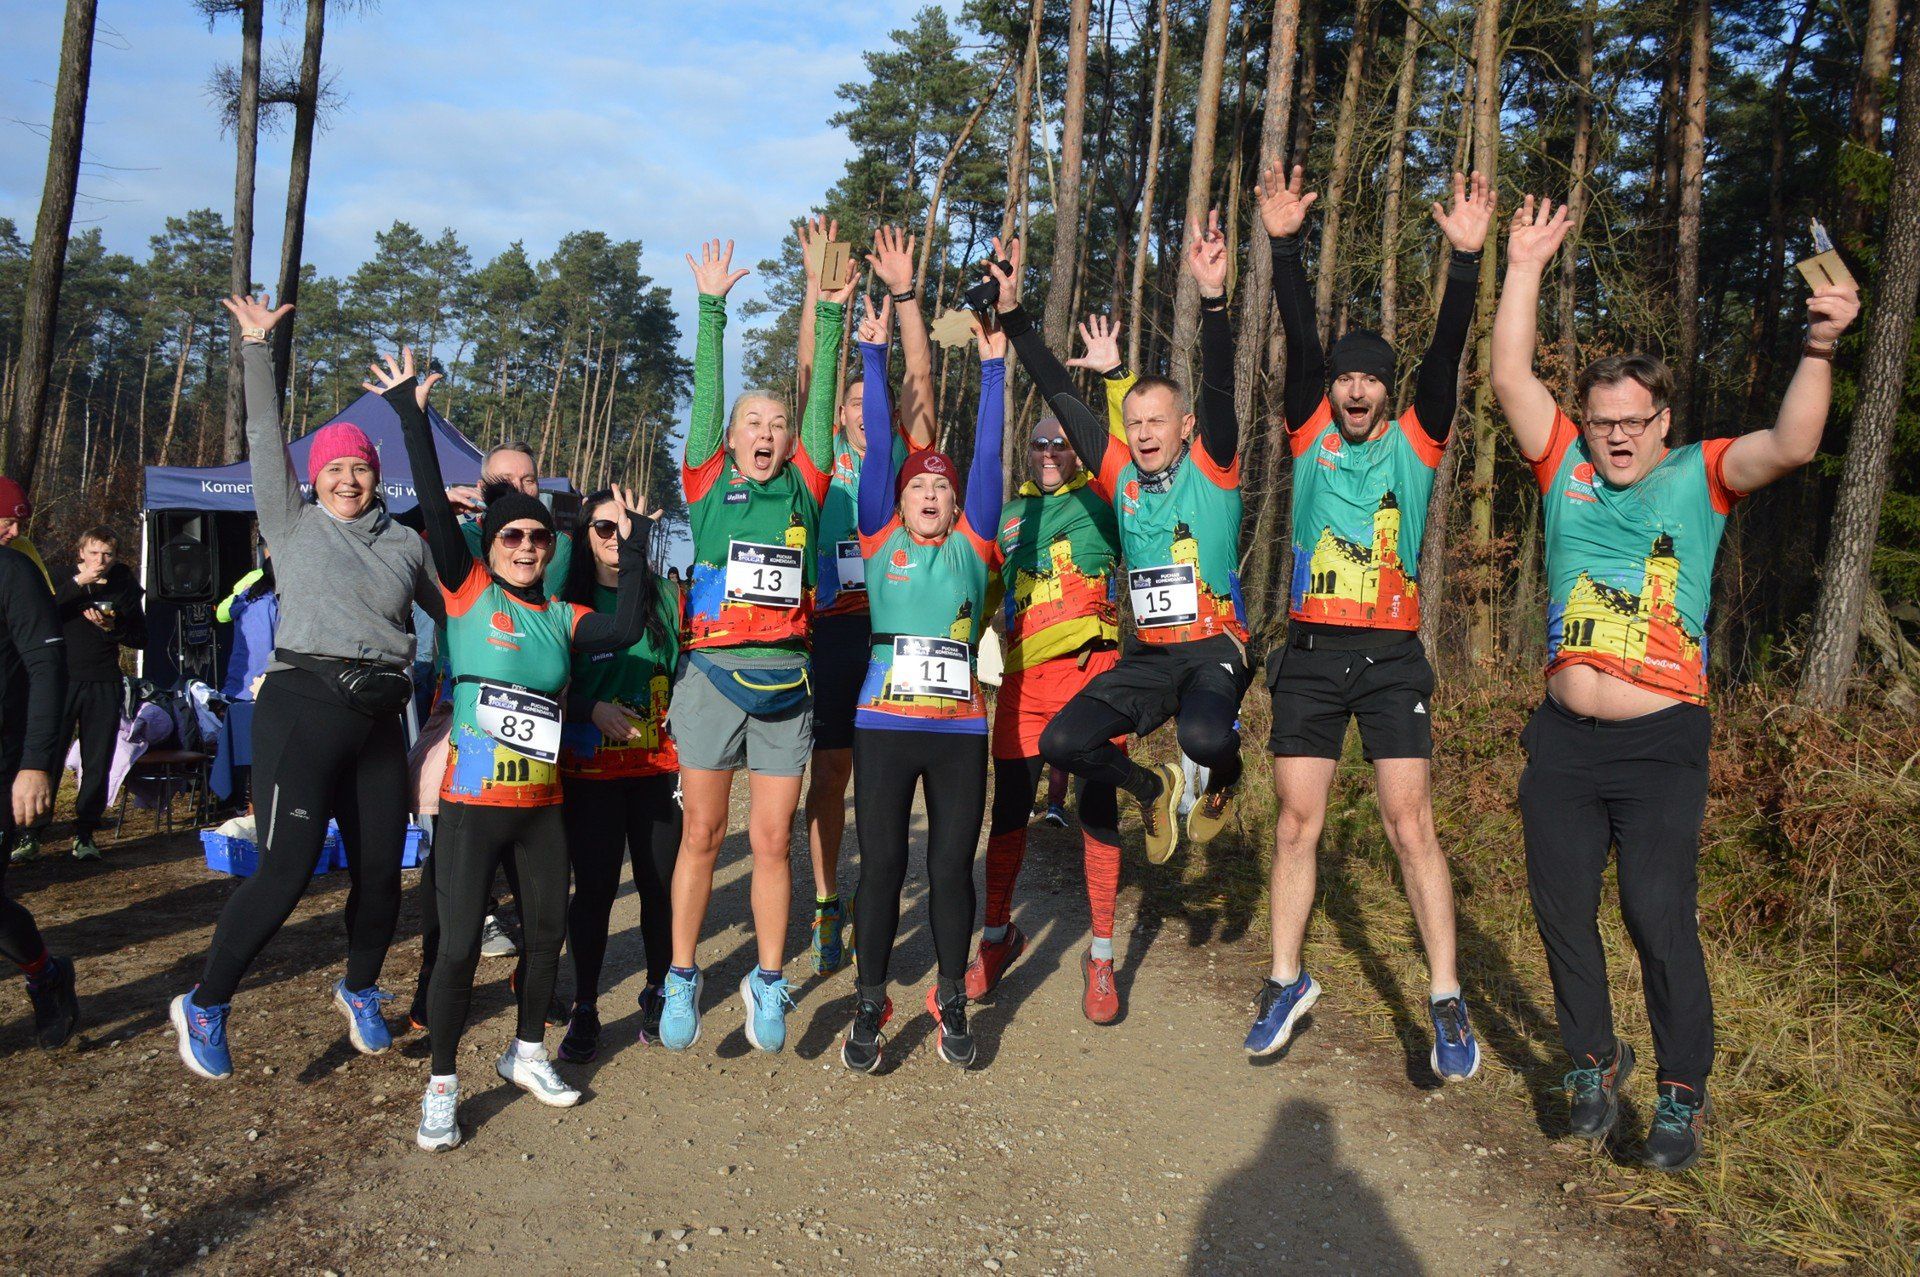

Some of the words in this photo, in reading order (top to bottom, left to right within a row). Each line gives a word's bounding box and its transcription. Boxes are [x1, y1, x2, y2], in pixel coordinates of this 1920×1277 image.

[201, 480, 254, 494] Komen
[384, 483, 402, 498] icji
[752, 568, 782, 592] 13
[1146, 589, 1172, 613] 15
[920, 660, 948, 683] 11
[500, 715, 536, 742] 83
